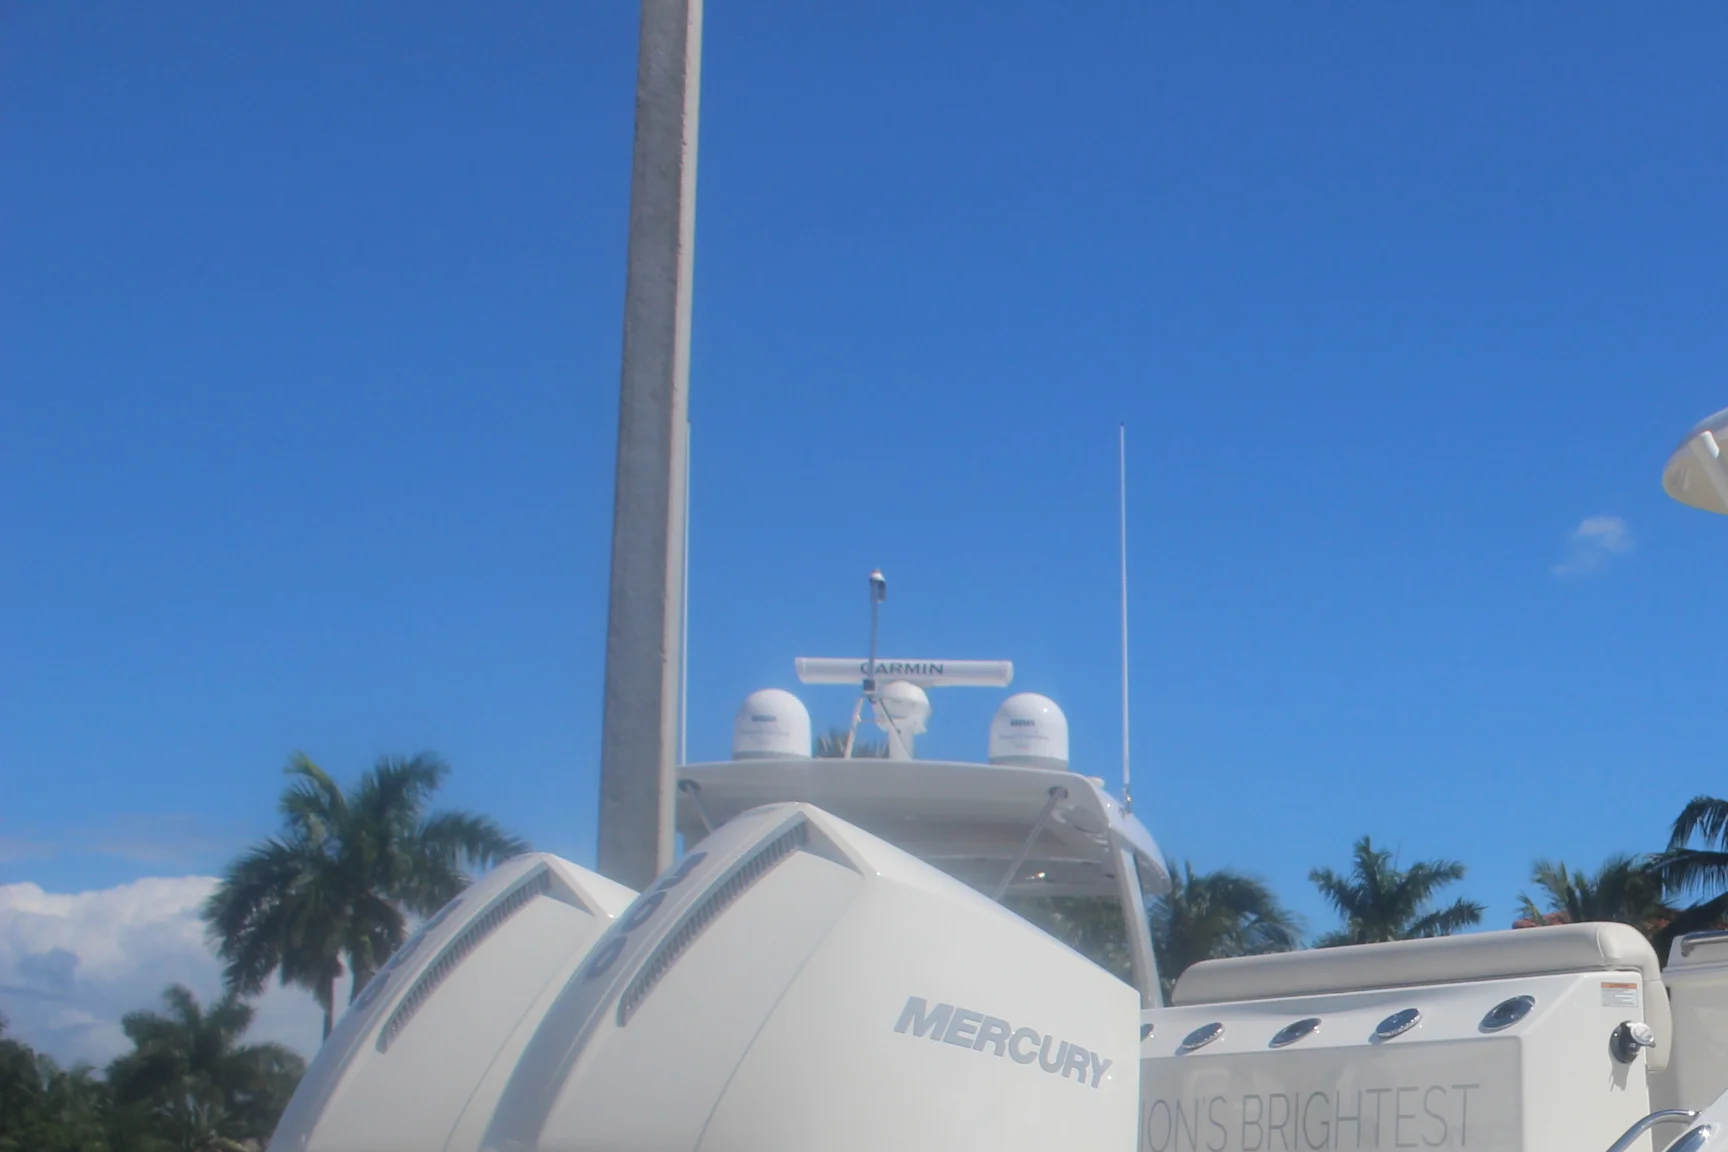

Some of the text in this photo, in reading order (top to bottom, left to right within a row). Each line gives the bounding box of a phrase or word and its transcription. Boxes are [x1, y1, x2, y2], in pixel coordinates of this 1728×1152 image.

[860, 662, 944, 676] GARMIN
[893, 996, 1113, 1088] MERCURY
[1241, 1084, 1480, 1152] BRIGHTEST
